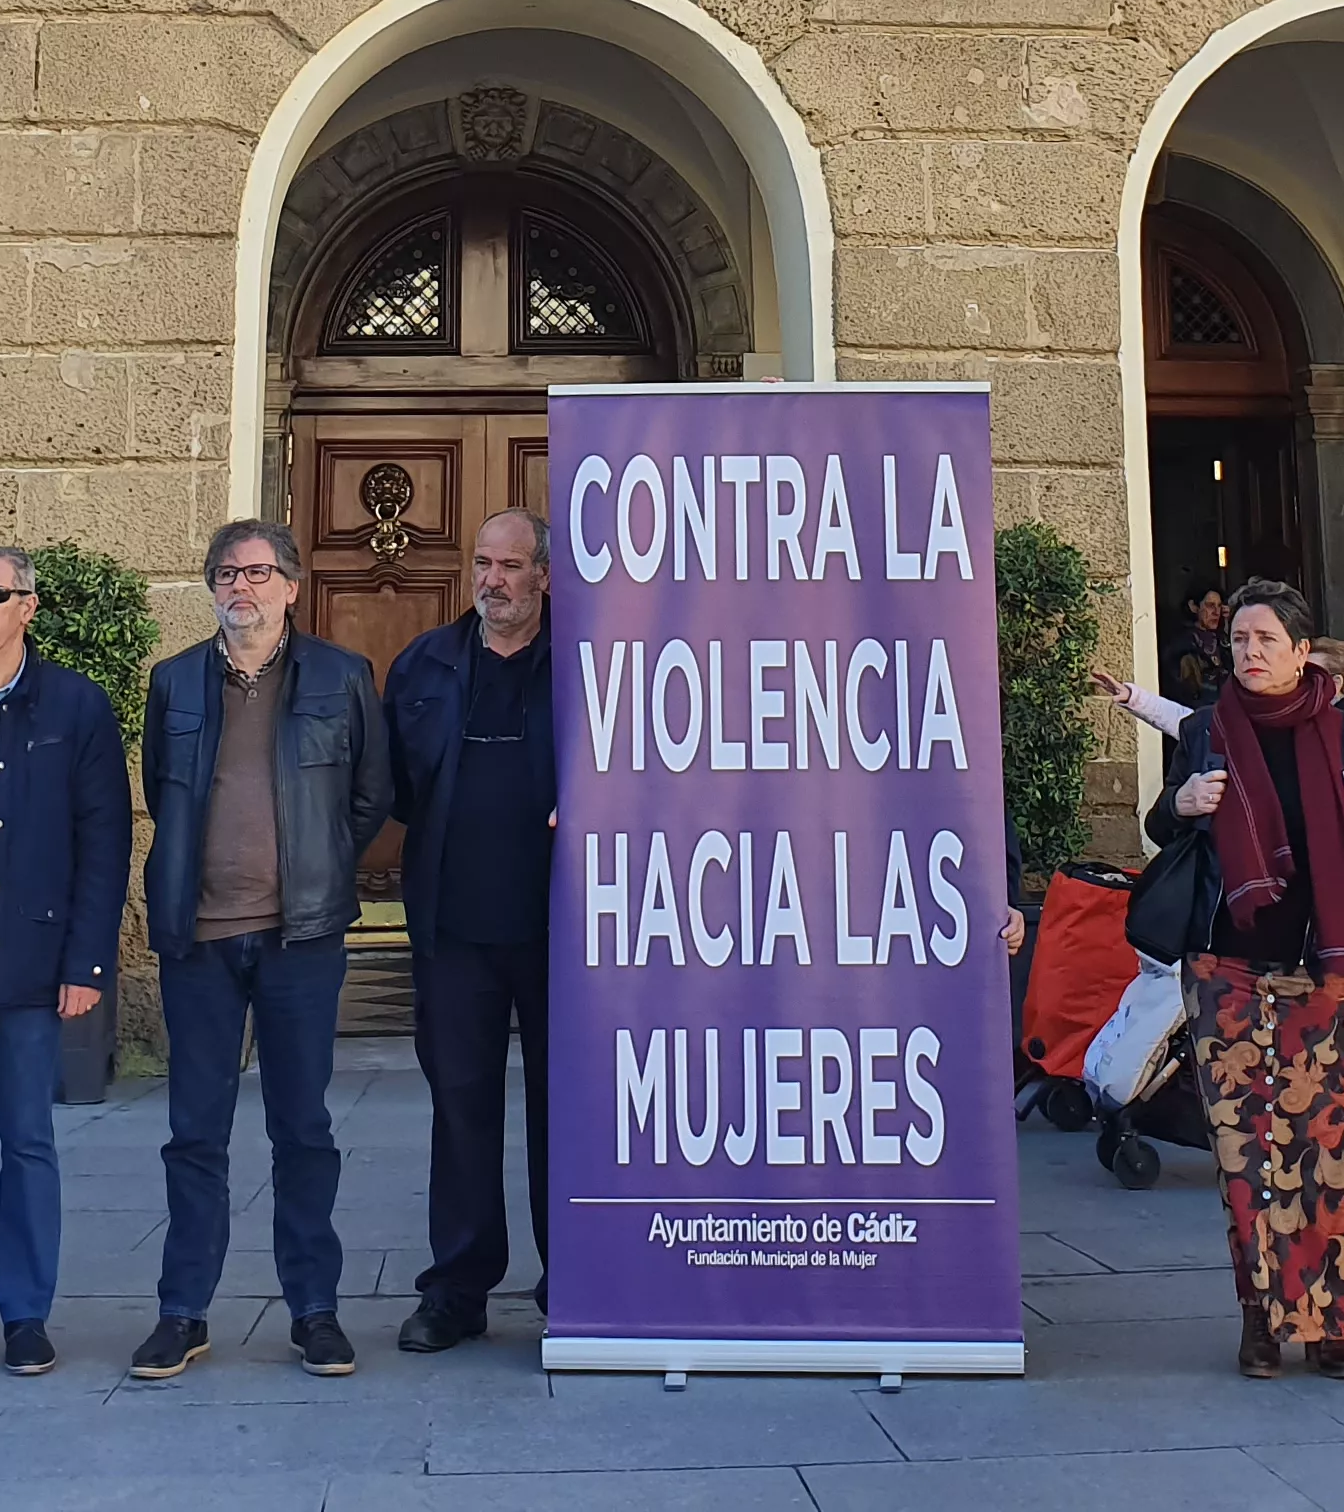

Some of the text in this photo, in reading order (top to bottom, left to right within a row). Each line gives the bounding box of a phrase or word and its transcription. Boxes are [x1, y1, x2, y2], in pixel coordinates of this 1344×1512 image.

[569, 454, 974, 584] CONTRA LA
[578, 638, 969, 773] VIOLENCIA
[585, 830, 968, 967] HACIA LAS
[616, 1026, 945, 1166] MUJERES
[648, 1211, 917, 1248] Ayuntamiento de Cádiz
[687, 1249, 878, 1270] Fundación Municipal de la Mujer
